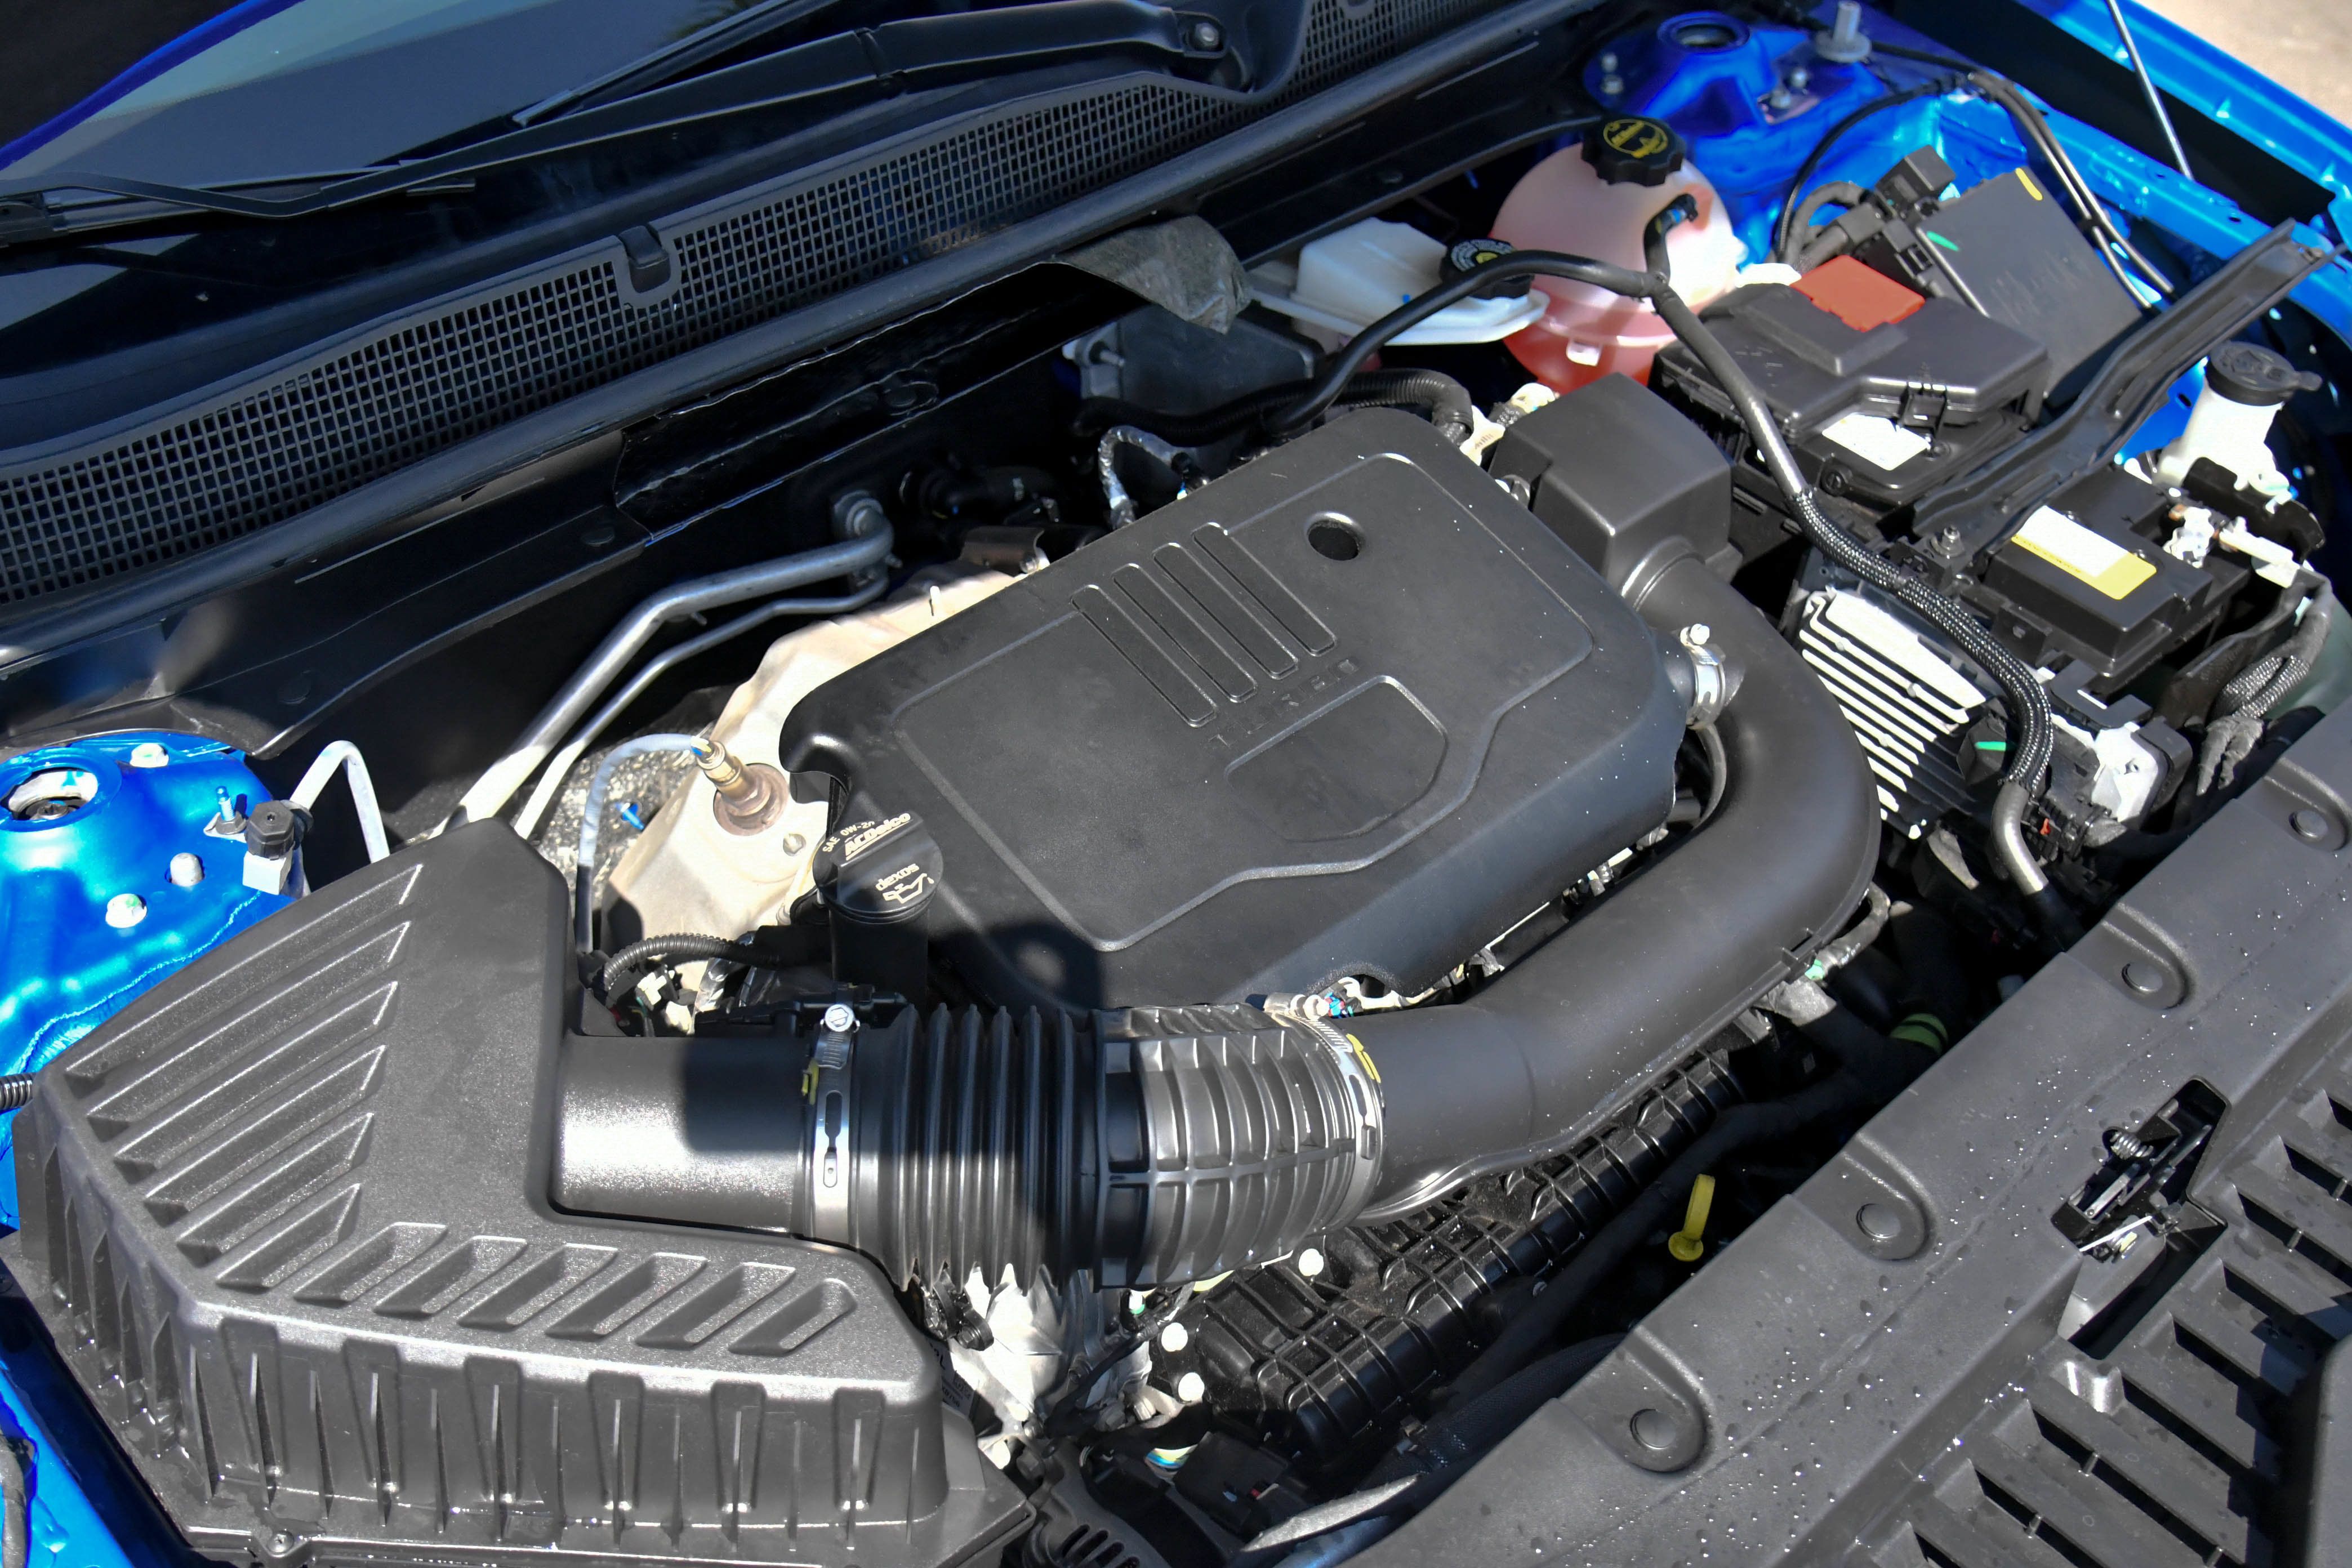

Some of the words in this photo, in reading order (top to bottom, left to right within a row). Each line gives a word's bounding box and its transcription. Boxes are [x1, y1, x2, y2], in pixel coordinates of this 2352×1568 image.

[822, 836, 840, 852] SAE
[845, 813, 911, 856] ACDelco
[875, 863, 920, 891] dexos
